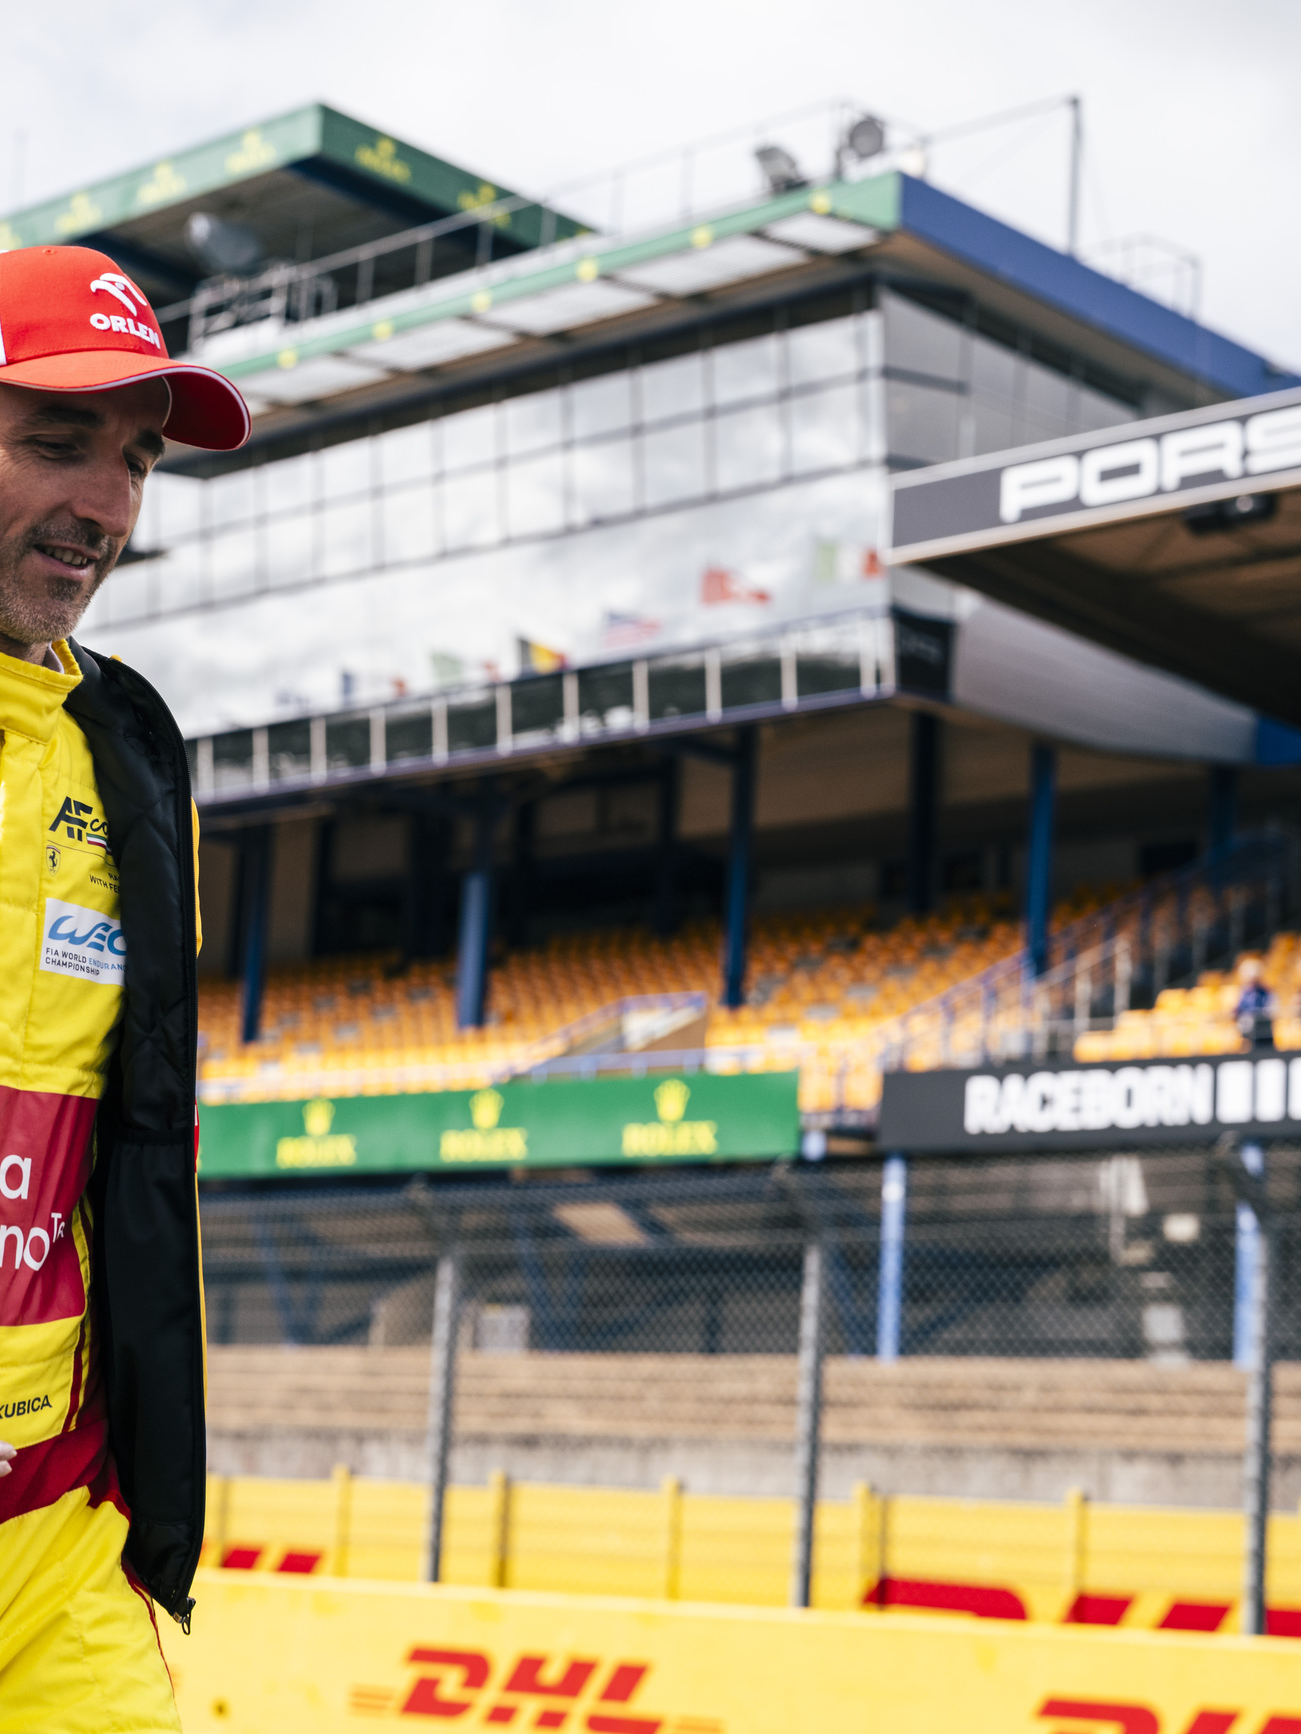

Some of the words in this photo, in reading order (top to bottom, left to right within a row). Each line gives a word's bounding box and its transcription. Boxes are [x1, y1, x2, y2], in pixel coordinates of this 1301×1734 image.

[90, 313, 161, 349] ORLEN
[1000, 404, 1301, 524] PORS
[90, 874, 108, 889] WITH
[45, 947, 59, 957] FIA
[61, 950, 87, 964] WORLD
[88, 957, 127, 972] ENDURAN
[45, 956, 100, 977] CHAMPIONSHIP
[963, 1063, 1215, 1135] RACEBORN
[400, 1646, 666, 1734] DHL
